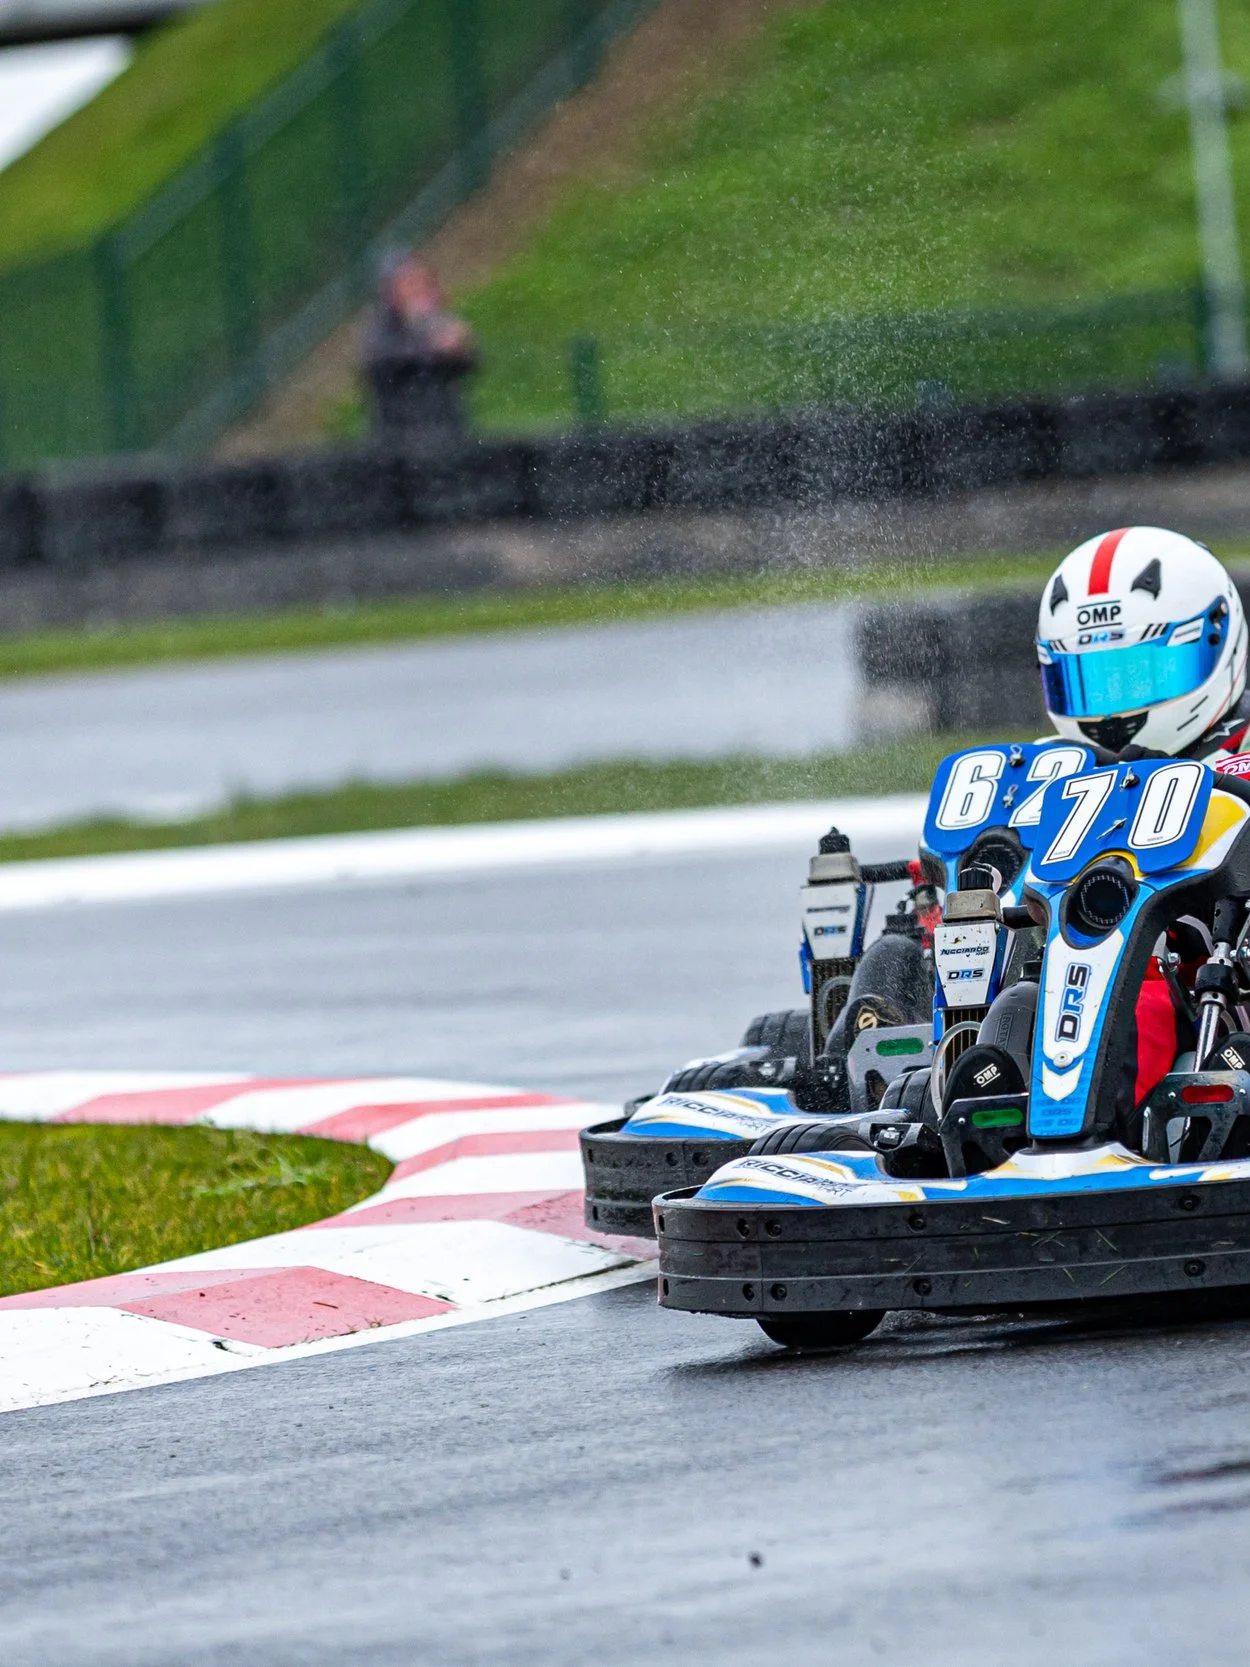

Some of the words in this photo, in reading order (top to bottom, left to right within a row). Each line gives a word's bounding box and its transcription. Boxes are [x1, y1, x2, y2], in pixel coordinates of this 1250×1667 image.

[1077, 605, 1122, 626] OMP
[936, 747, 1088, 831] 62
[1041, 761, 1206, 866] 70
[947, 968, 985, 981] DRS
[1058, 964, 1090, 1041] DRS
[997, 1015, 1013, 1047] ROTA
[1223, 1048, 1244, 1070] OMP
[975, 1065, 998, 1085] OMP
[735, 1159, 868, 1190] RICCIA
